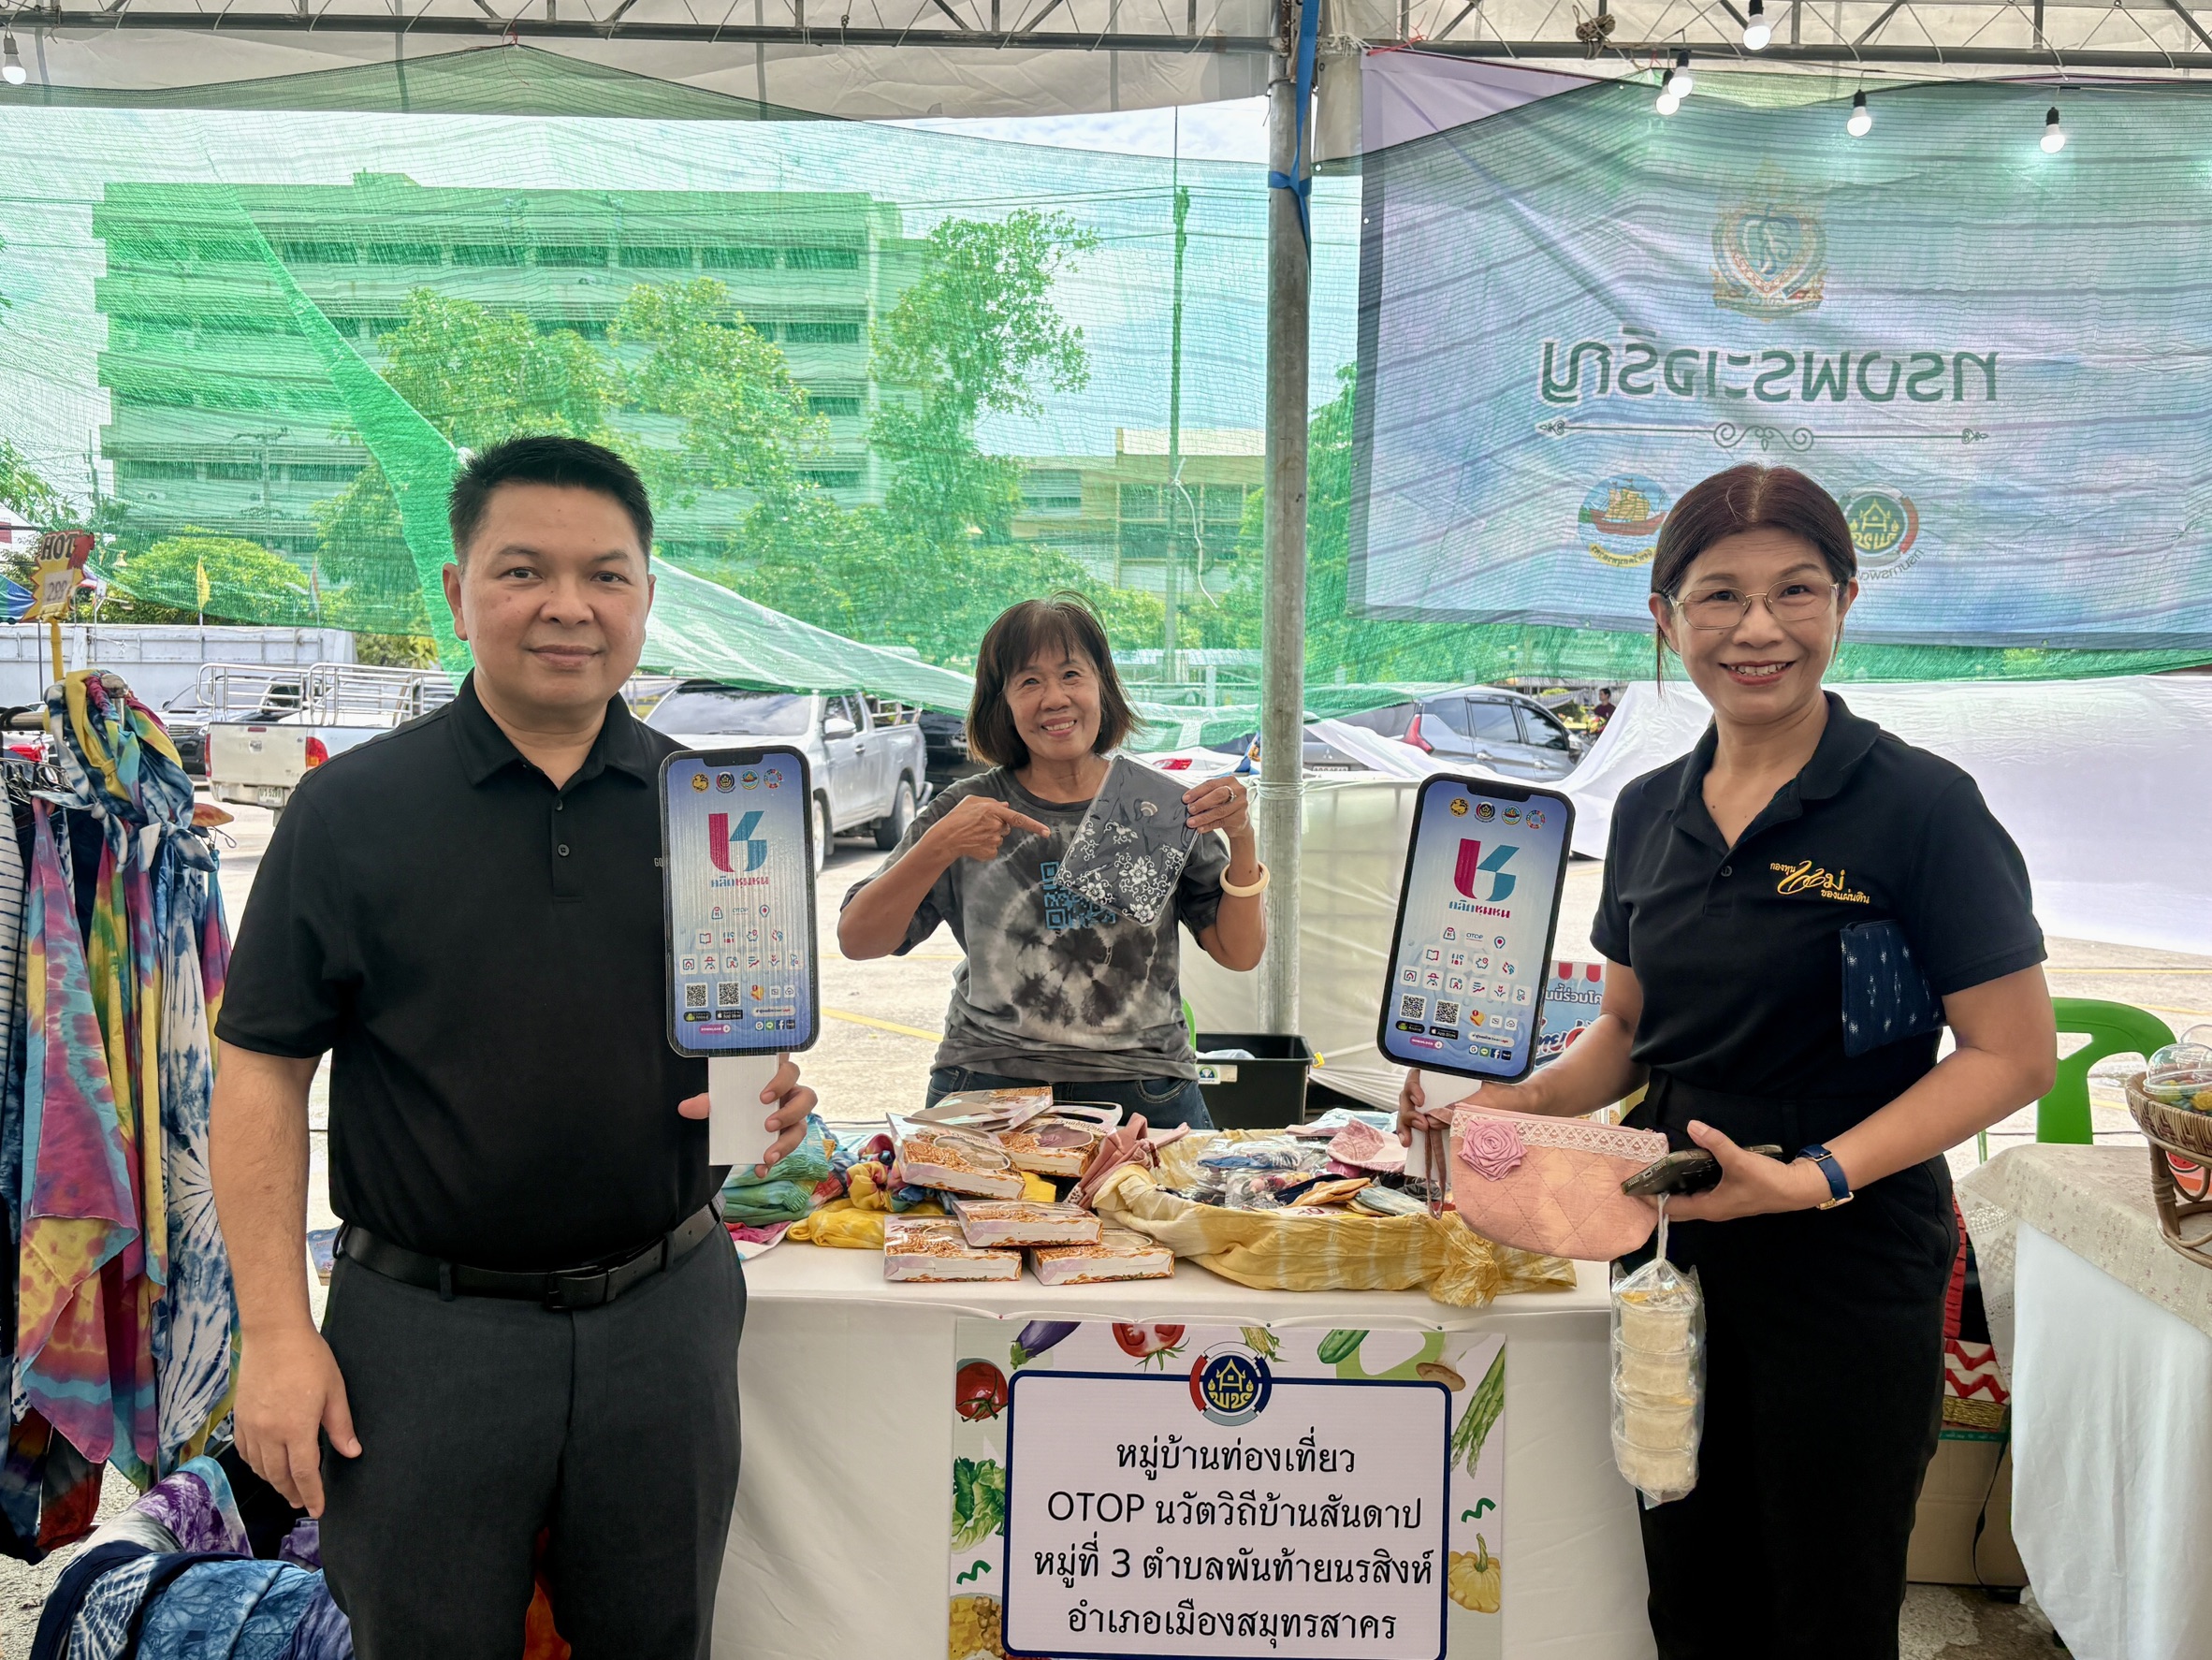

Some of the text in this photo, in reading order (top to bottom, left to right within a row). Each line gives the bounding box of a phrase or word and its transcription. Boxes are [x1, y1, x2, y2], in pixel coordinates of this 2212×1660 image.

[40, 532, 78, 561] HOT
[1769, 862, 1797, 877] กองทุน
[1116, 1425, 1355, 1481] หมู่บ้านท่องเที่ยว
[1047, 1489, 1421, 1529] OTOP นวัตวิถีบ้านสันดาป
[1034, 1530, 1434, 1589] หมู่ที่ 3 ตำบลพันท้ายนรสิงห์
[1068, 1597, 1397, 1650] อำเภอเมืองสมุทรสาคร
